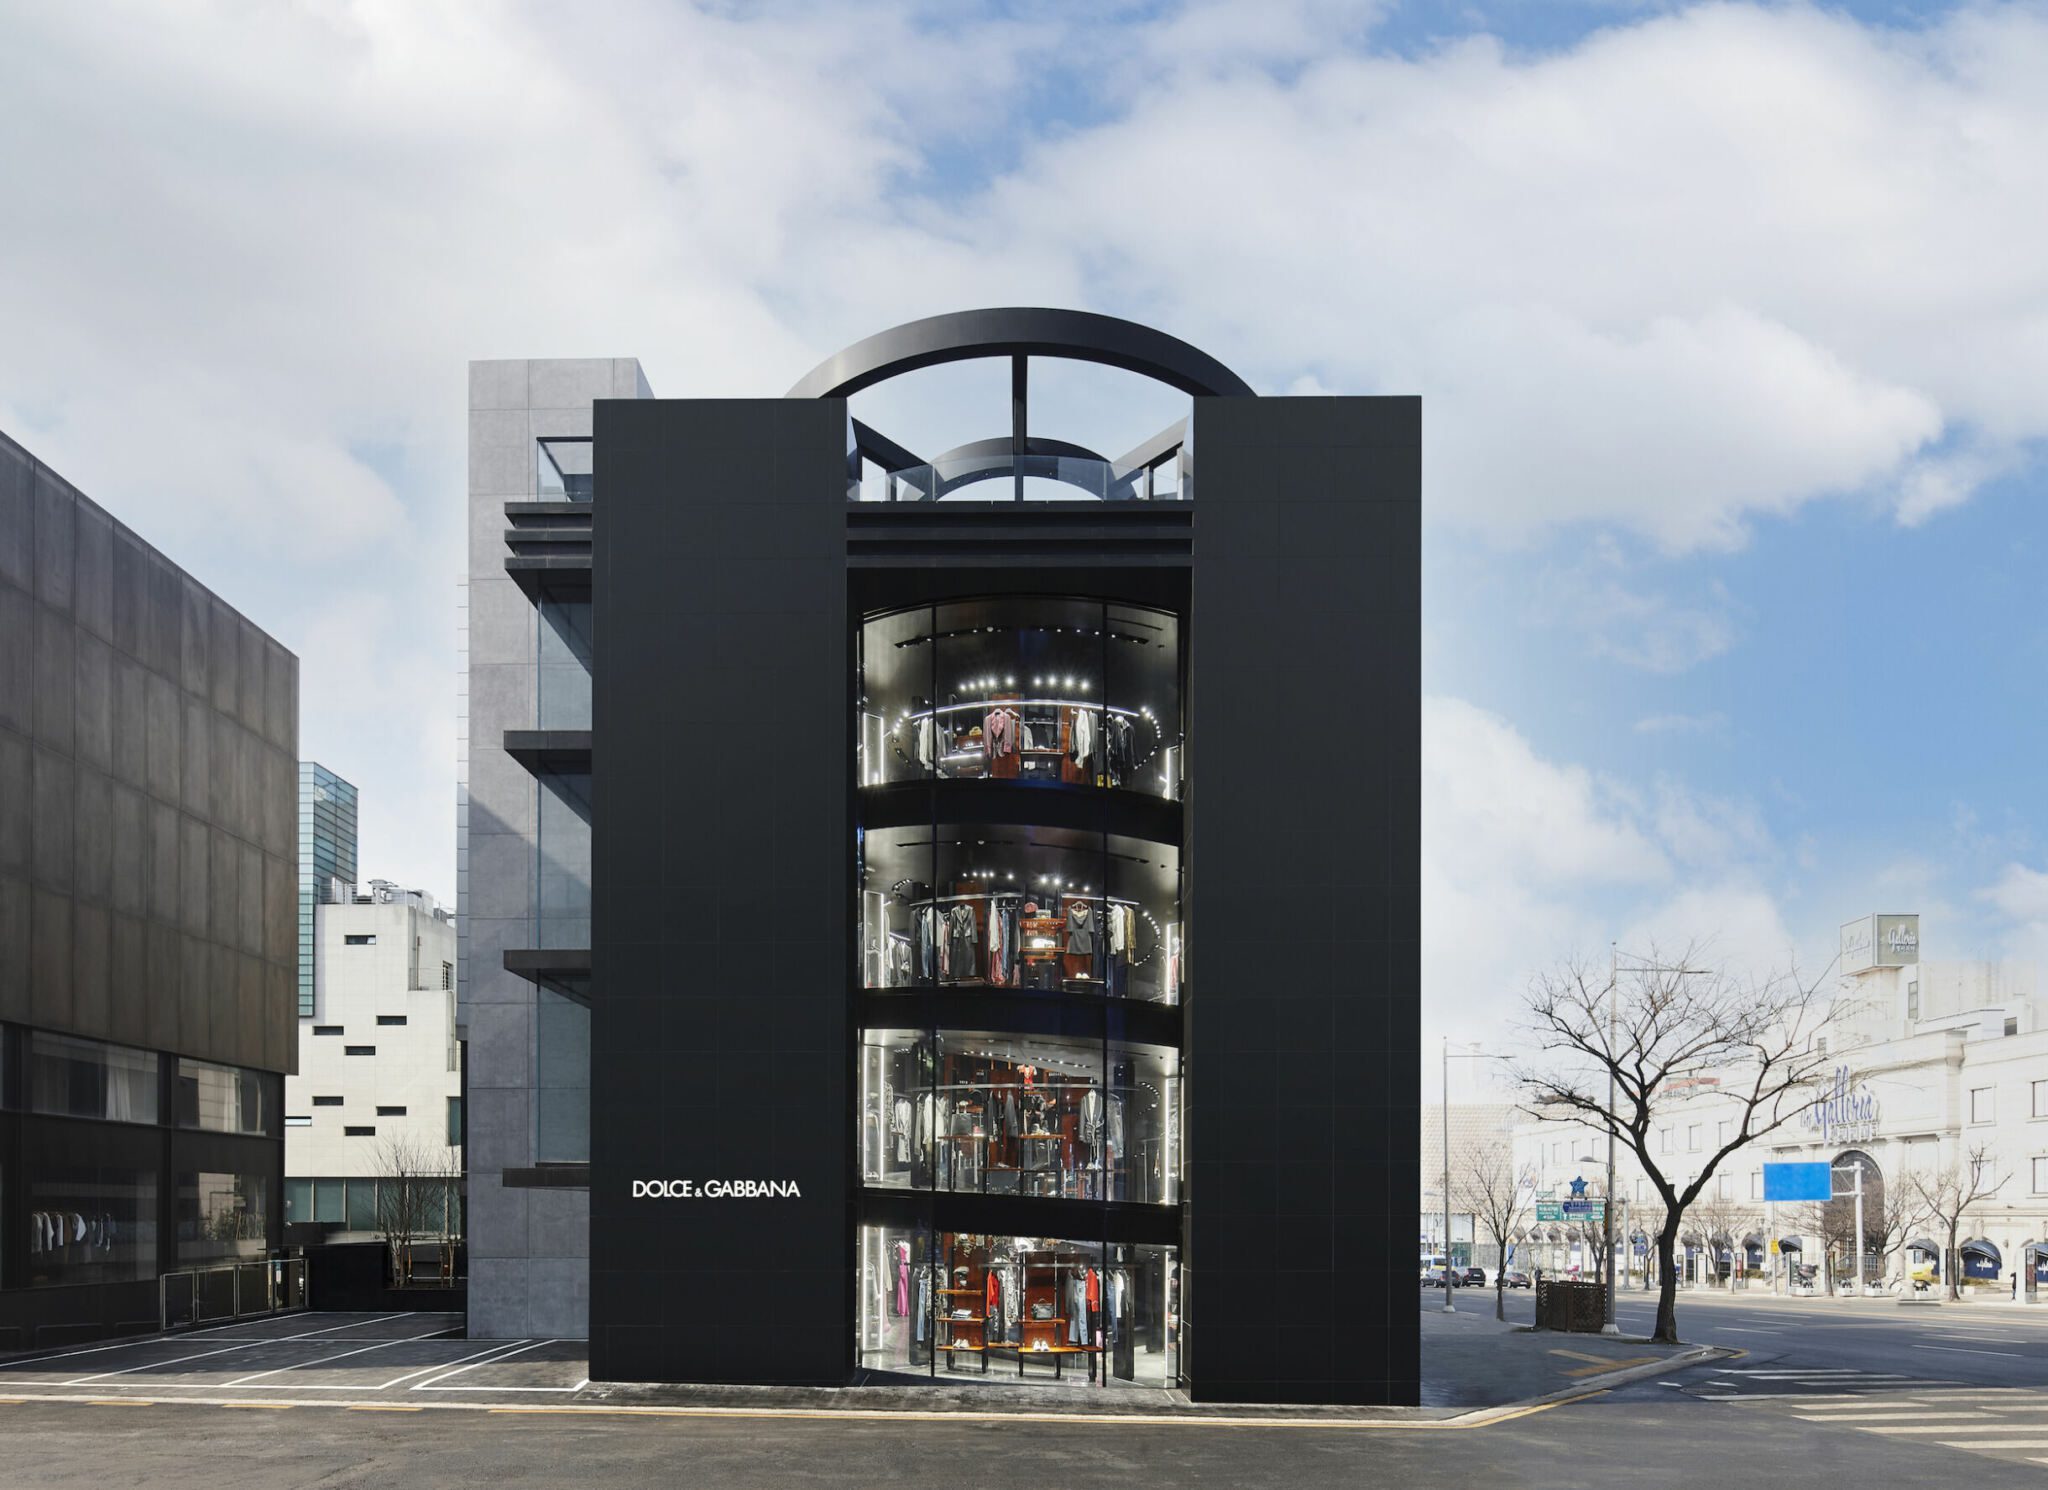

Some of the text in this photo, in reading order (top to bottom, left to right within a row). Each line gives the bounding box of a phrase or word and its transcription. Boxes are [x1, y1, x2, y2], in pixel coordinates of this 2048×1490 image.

[1814, 1064, 1873, 1139] Galleria
[632, 1180, 801, 1198] DOLCE & GABBANA
